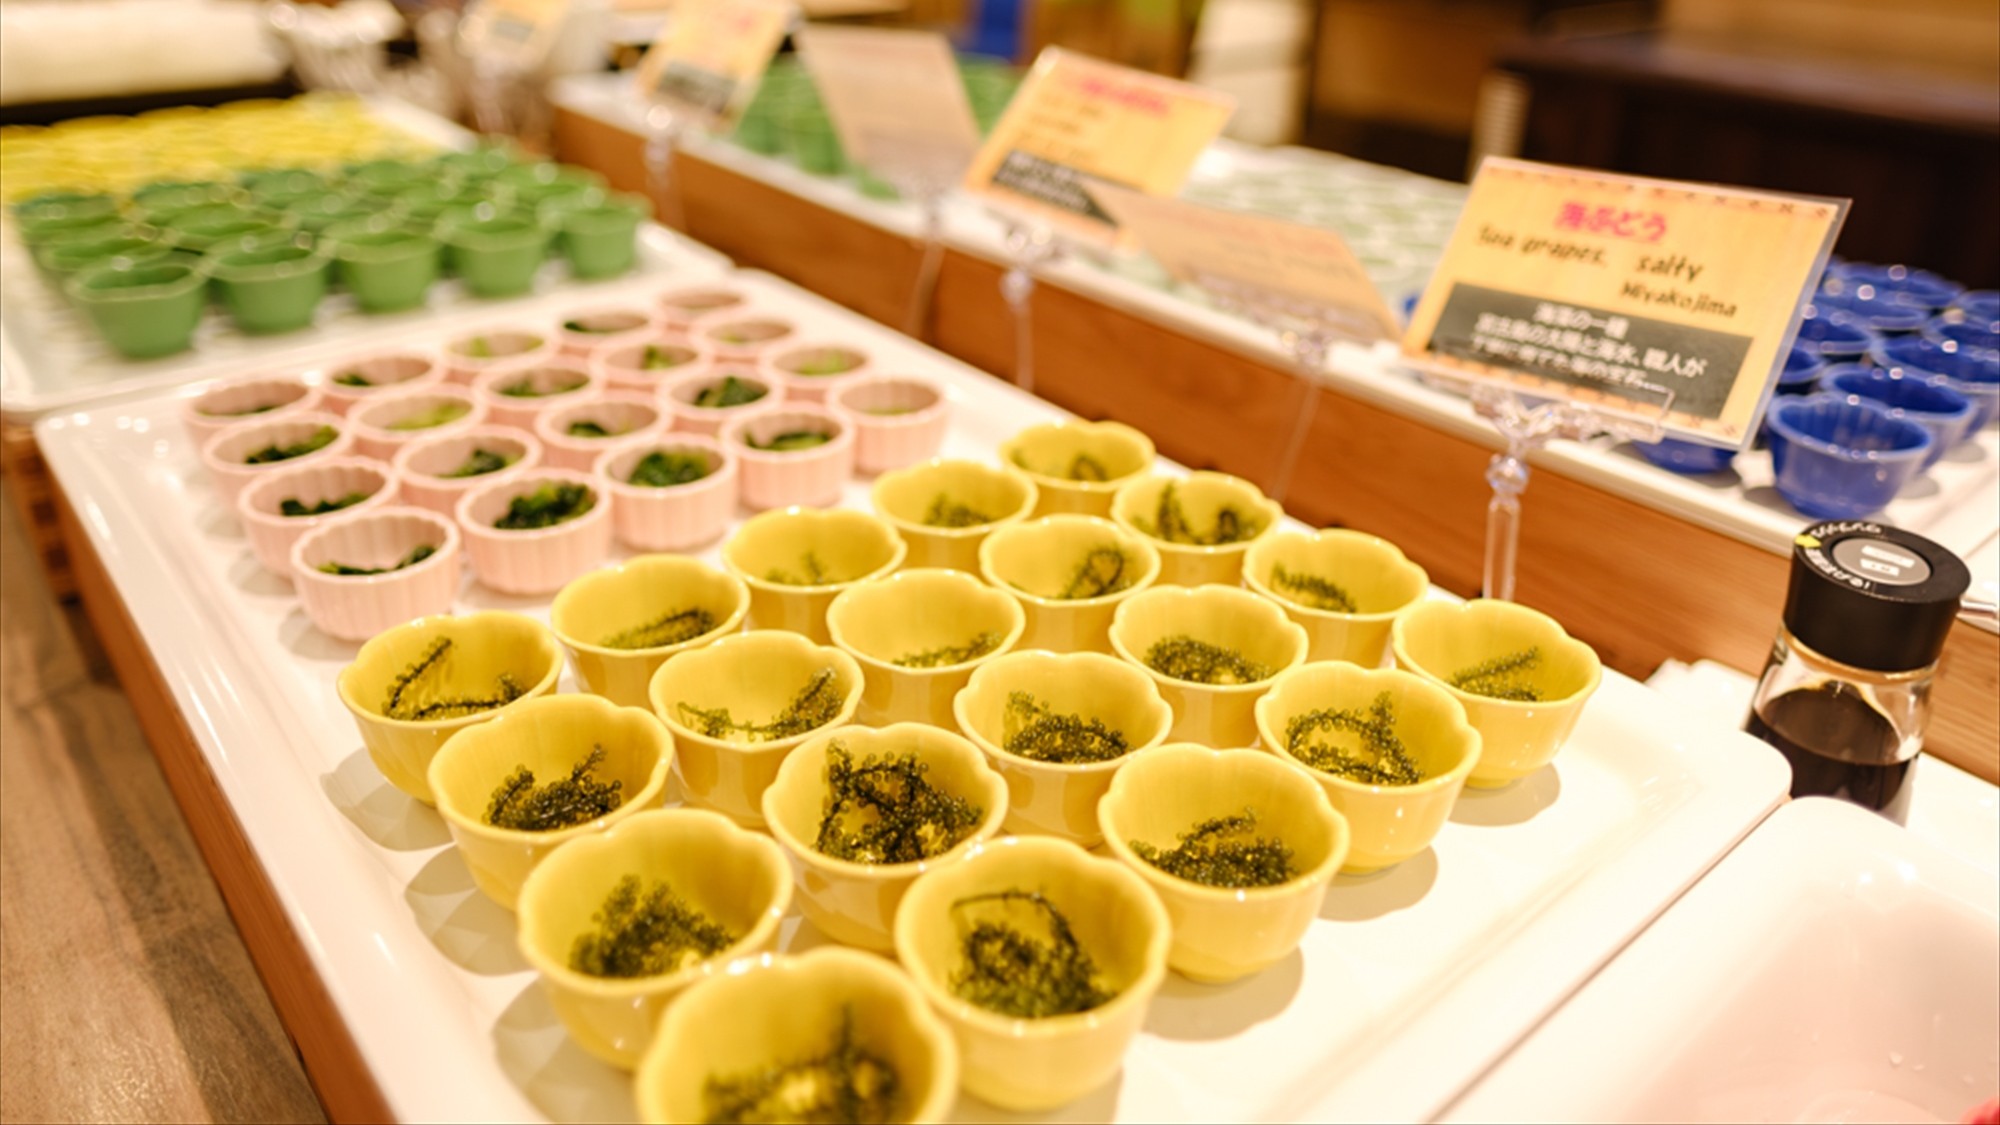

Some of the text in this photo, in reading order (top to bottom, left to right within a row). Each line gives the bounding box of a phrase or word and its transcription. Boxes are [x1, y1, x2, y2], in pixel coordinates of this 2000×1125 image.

[1558, 202, 1667, 242] 海ぶどう
[1637, 254, 1703, 282] salty
[1622, 283, 1737, 317] Miyakojima
